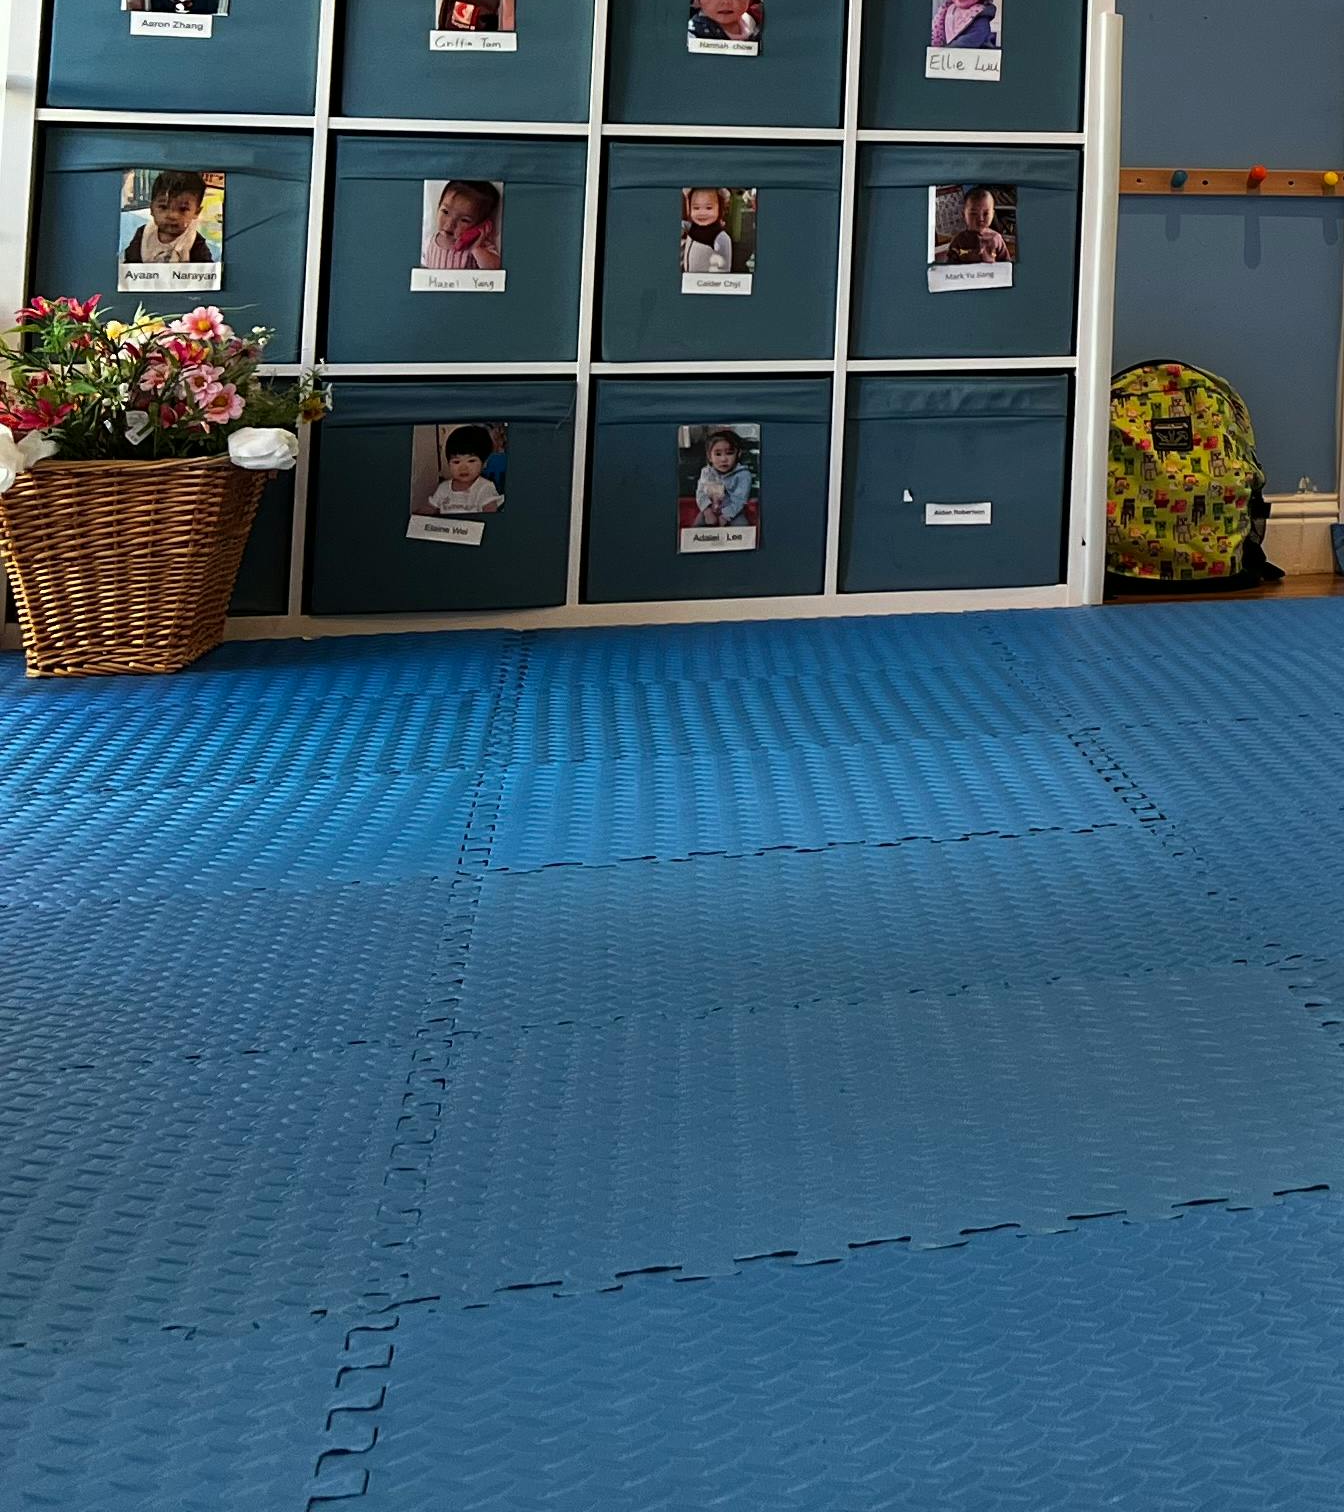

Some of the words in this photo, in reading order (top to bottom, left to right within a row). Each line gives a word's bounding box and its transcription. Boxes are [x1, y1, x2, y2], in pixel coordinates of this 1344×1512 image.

[141, 19, 171, 28] Aaron
[172, 21, 204, 31] Zhang
[929, 54, 965, 71] Ellie
[124, 270, 160, 280] Ayaan
[172, 270, 217, 281] Narayan
